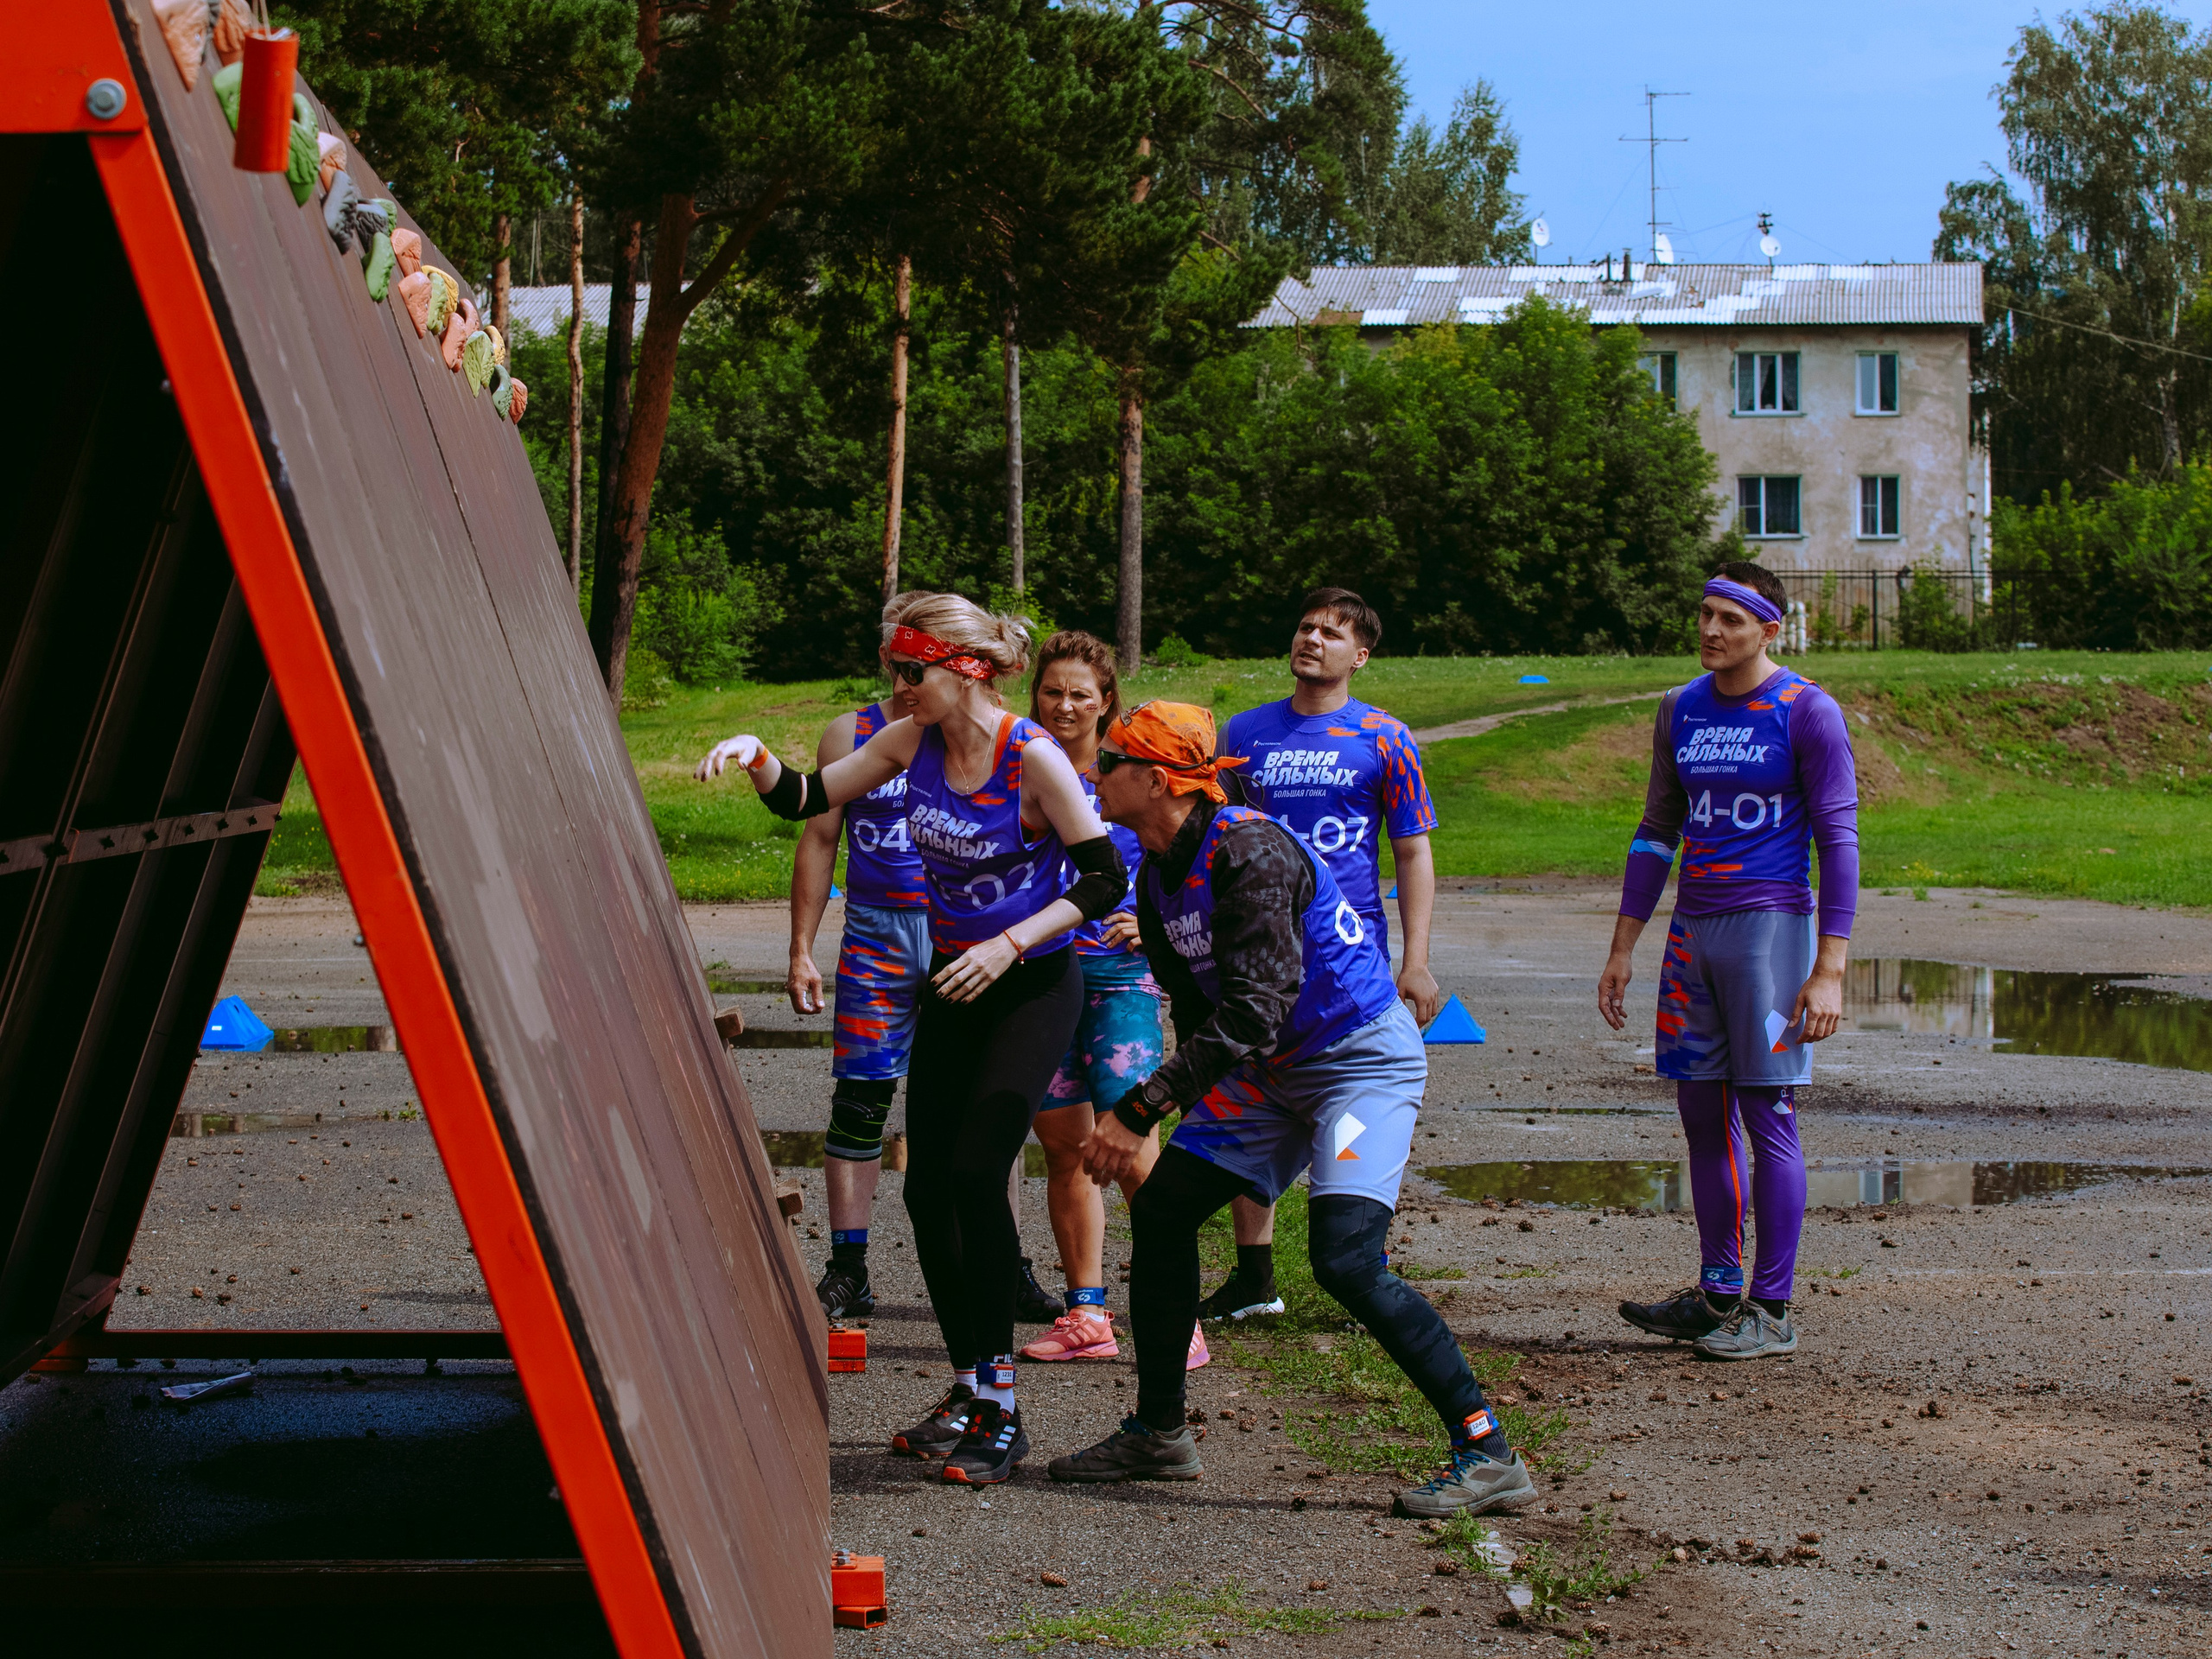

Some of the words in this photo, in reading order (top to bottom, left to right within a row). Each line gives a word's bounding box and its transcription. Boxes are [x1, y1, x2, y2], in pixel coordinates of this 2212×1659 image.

[1688, 727, 1754, 746] ВРЕМЯ
[1263, 750, 1339, 768] ВРЕМЯ
[1676, 743, 1770, 764] СИЛЬНЫХ
[1251, 766, 1359, 788] СИЛЬНЫХ
[1690, 766, 1719, 774] БОЛЬШАЯ
[1274, 790, 1305, 798] БОЛЬШАЯ
[1306, 789, 1326, 798] ГОНКА
[1686, 790, 1783, 830] 4-01
[910, 804, 982, 839] ВРЕМЯ
[907, 823, 1001, 861] ИЛЬНЫХ
[921, 849, 949, 863] БОЛЬШАЯ
